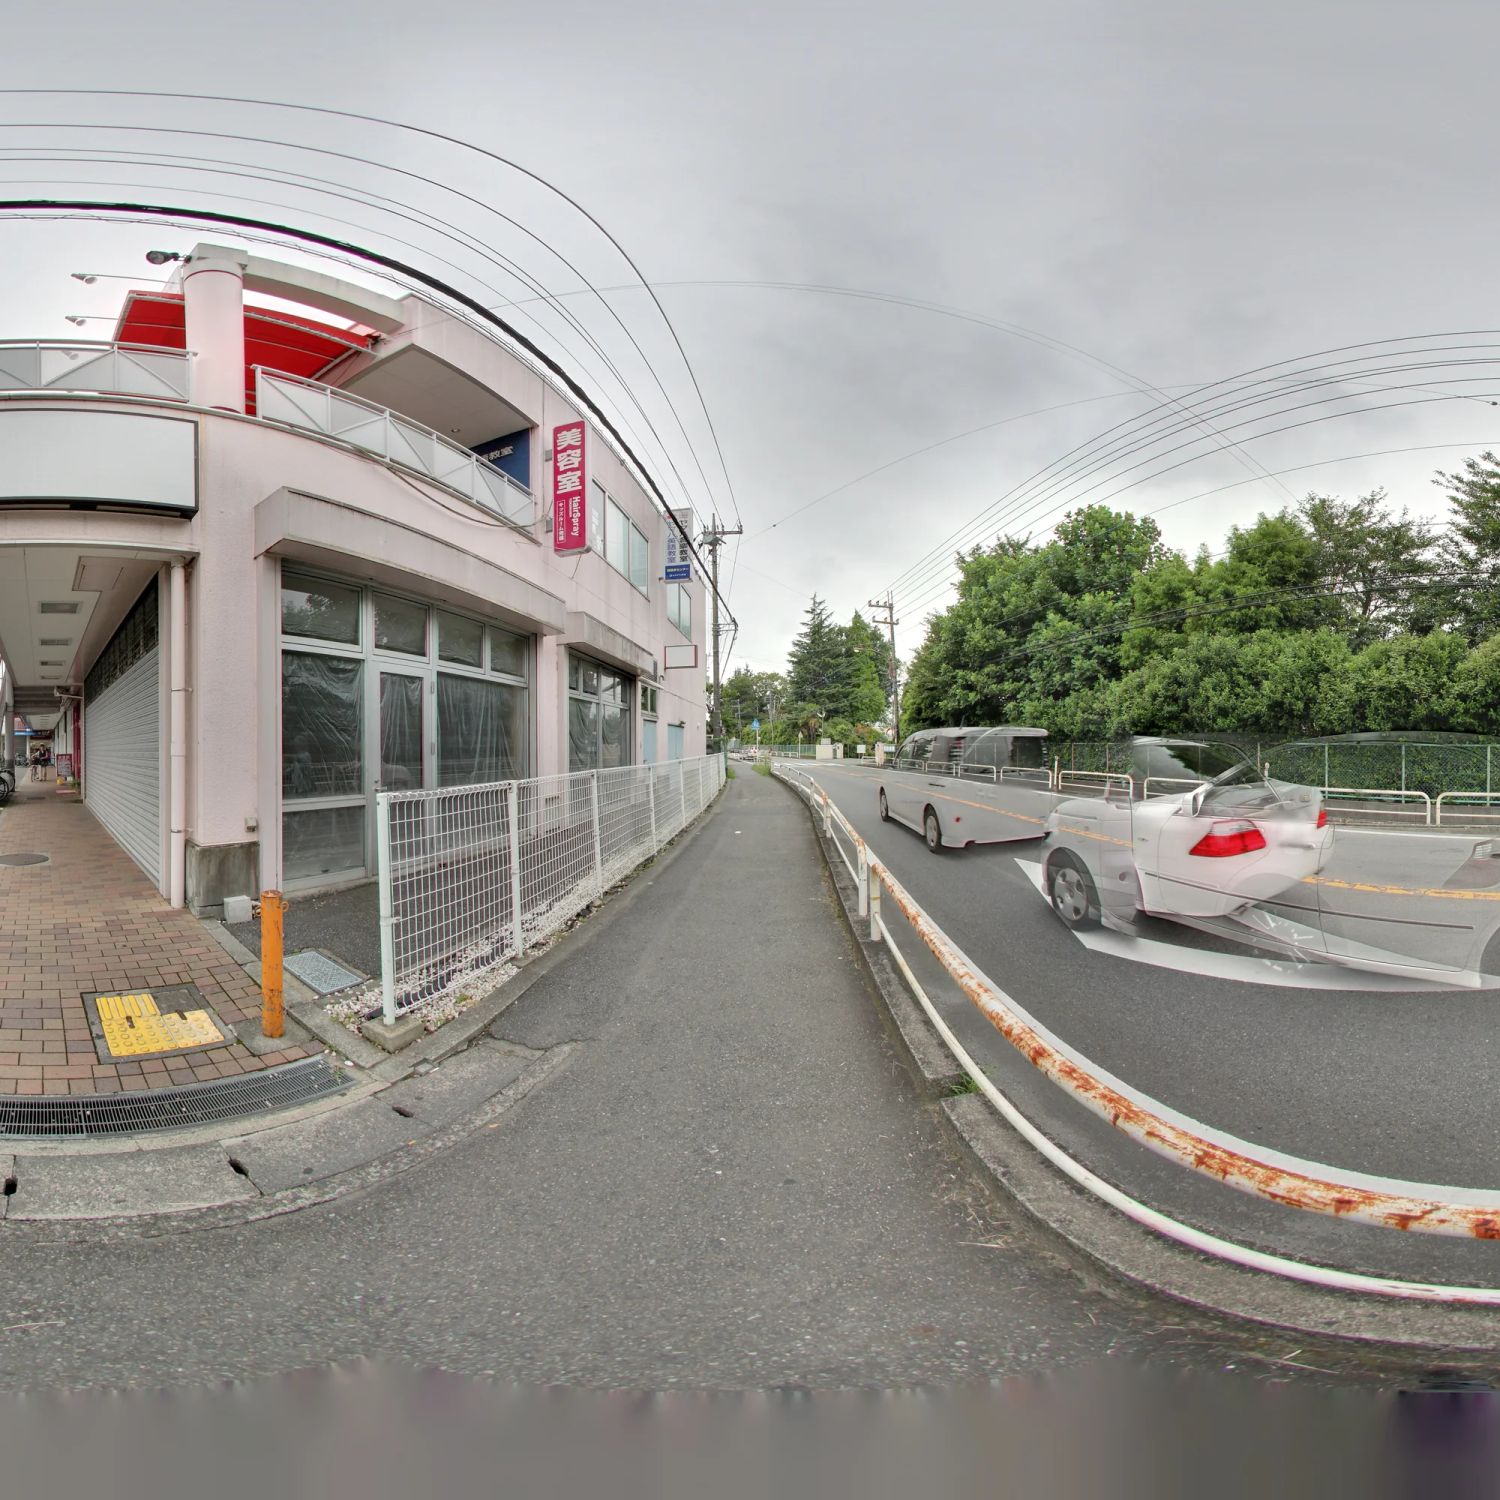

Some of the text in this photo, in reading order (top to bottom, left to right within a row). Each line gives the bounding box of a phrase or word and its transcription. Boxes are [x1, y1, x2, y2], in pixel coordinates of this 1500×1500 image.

[557, 428, 582, 494] 美容室
[572, 496, 581, 536] HairSpray
